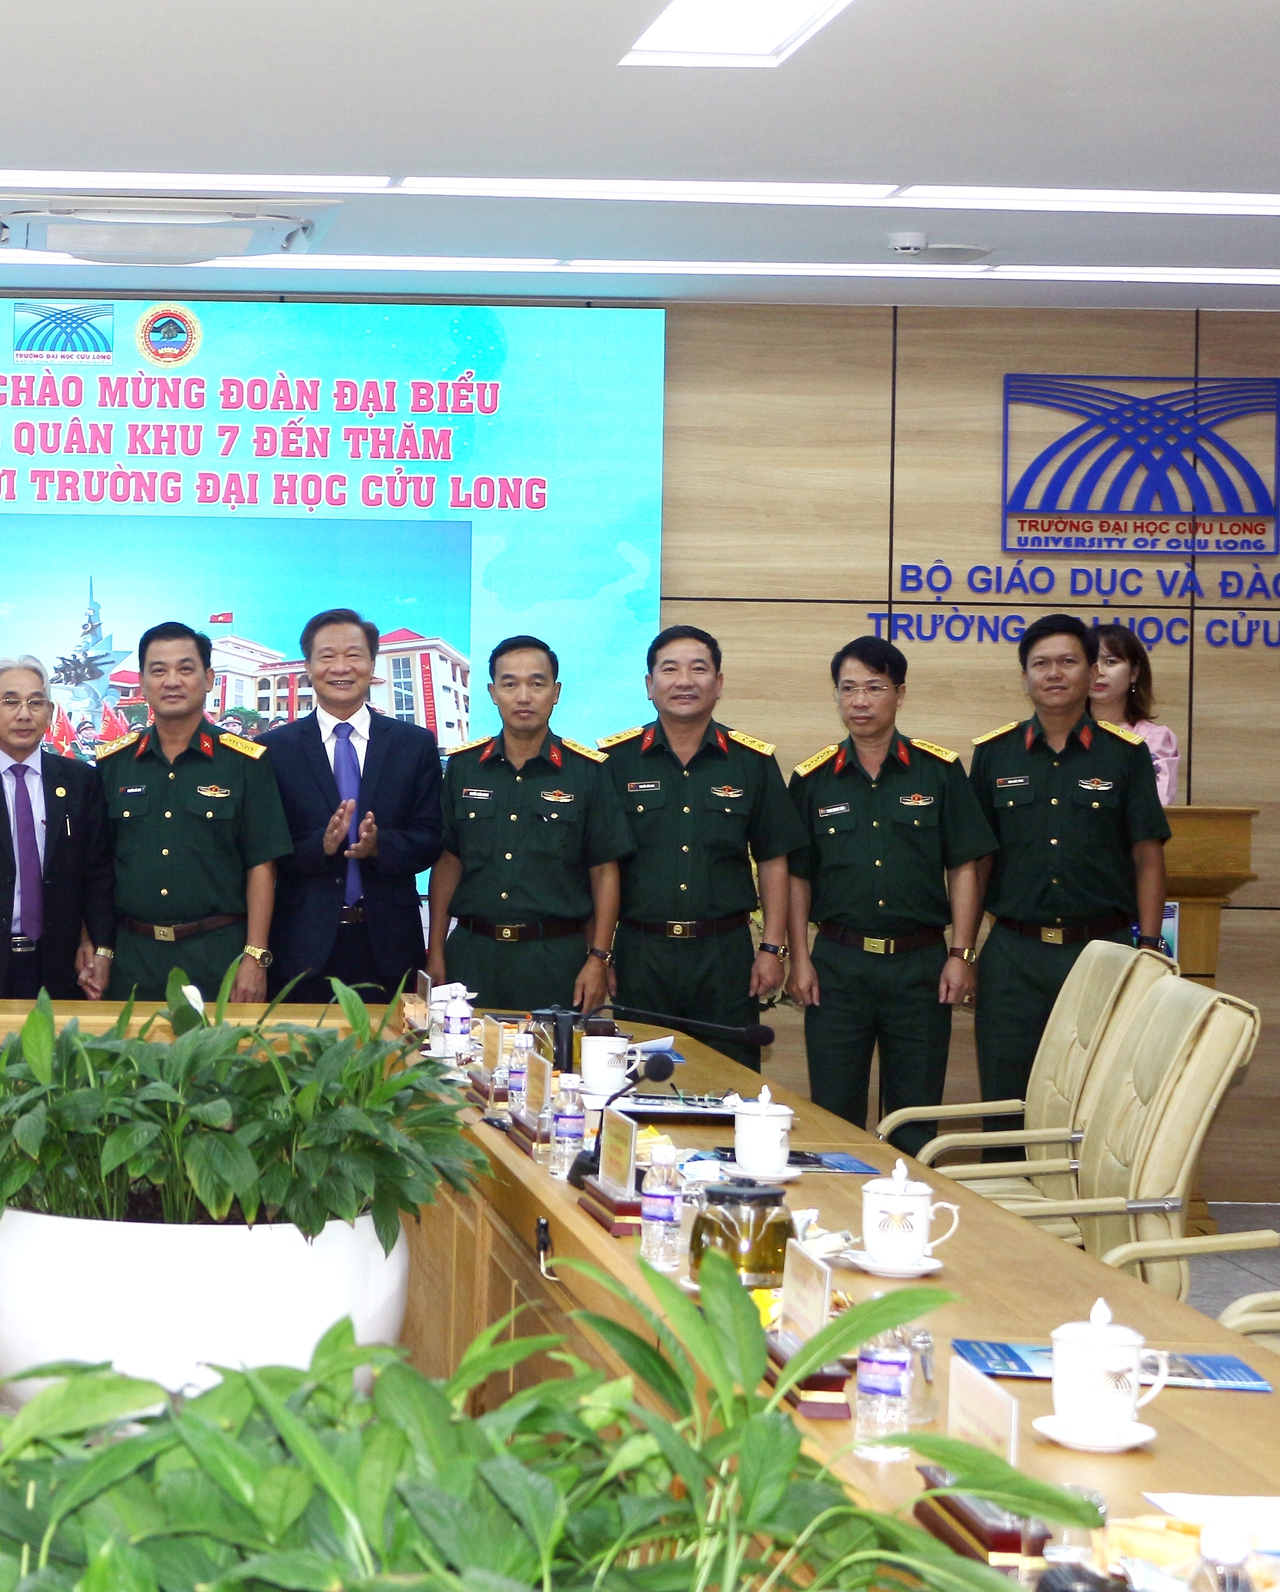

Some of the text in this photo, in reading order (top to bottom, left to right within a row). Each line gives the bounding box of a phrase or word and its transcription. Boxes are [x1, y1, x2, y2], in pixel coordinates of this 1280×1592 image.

[98, 371, 206, 409] MỪNG
[221, 372, 320, 412] ĐOÀN
[334, 380, 396, 418] ĐẠI
[410, 371, 500, 415] BIỂU
[14, 417, 113, 457] QUÂN
[127, 424, 204, 457] KHU
[217, 425, 240, 457] 7
[253, 418, 330, 458] ĐẾN
[344, 423, 453, 461] THĂM
[31, 464, 182, 503] TRƯỜNG
[197, 472, 259, 511] ĐẠI
[273, 474, 346, 513] HỌC
[361, 466, 436, 508] CỬU
[450, 476, 547, 510] LONG
[1017, 517, 1094, 533] TRƯỜNG
[1098, 520, 1128, 535] ĐẠI
[1133, 521, 1170, 537] HỌC
[1219, 522, 1266, 535] LONG
[1017, 536, 1127, 548] UNIVERSITY
[1133, 537, 1161, 549] OF
[1215, 539, 1266, 550] LONG
[900, 559, 952, 602] BỘ
[967, 559, 1055, 594] GIÁO
[1070, 568, 1143, 605] DỤC
[1156, 562, 1204, 598] VÀ
[867, 607, 1026, 643] TRƯỜNG
[1205, 611, 1280, 647] CỬU
